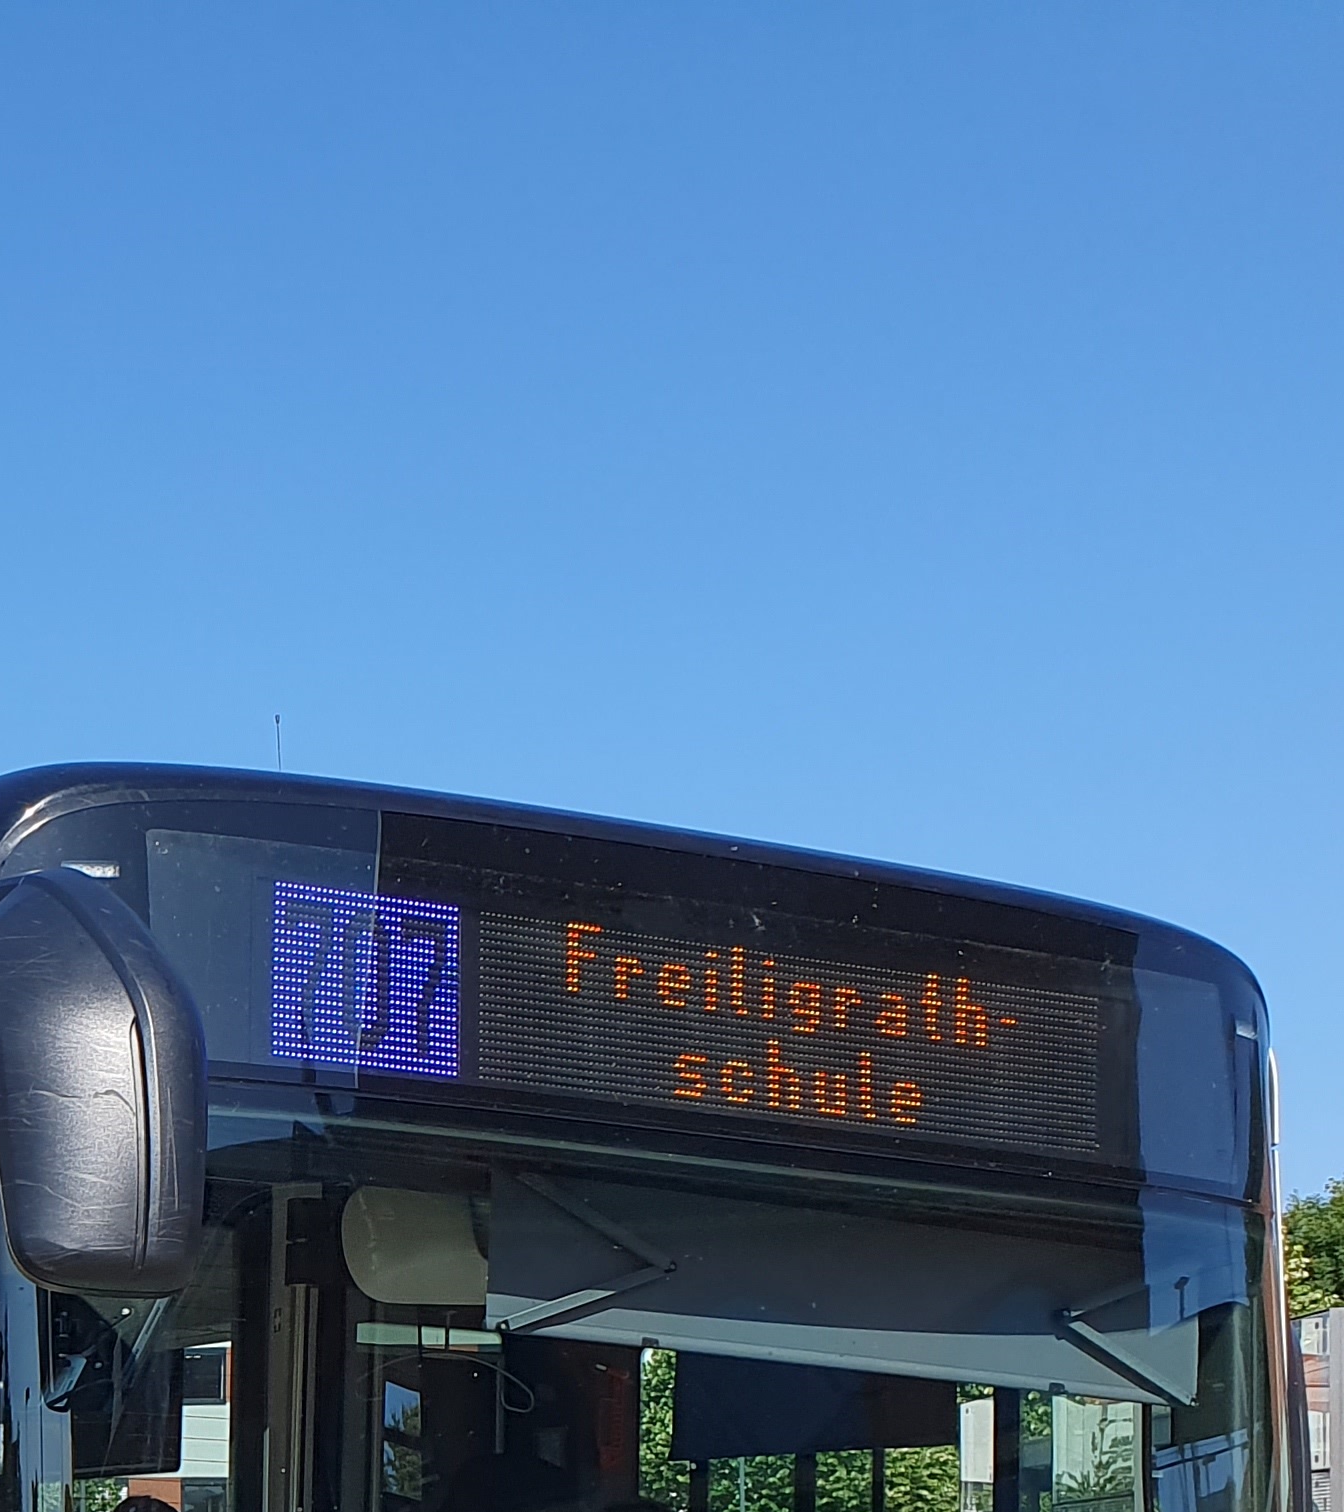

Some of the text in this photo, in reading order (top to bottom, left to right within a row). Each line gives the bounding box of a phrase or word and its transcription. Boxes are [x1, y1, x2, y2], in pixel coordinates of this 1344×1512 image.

[280, 896, 452, 1060] 707
[566, 921, 1018, 1047] Freiligrath-
[672, 1037, 923, 1124] schule
